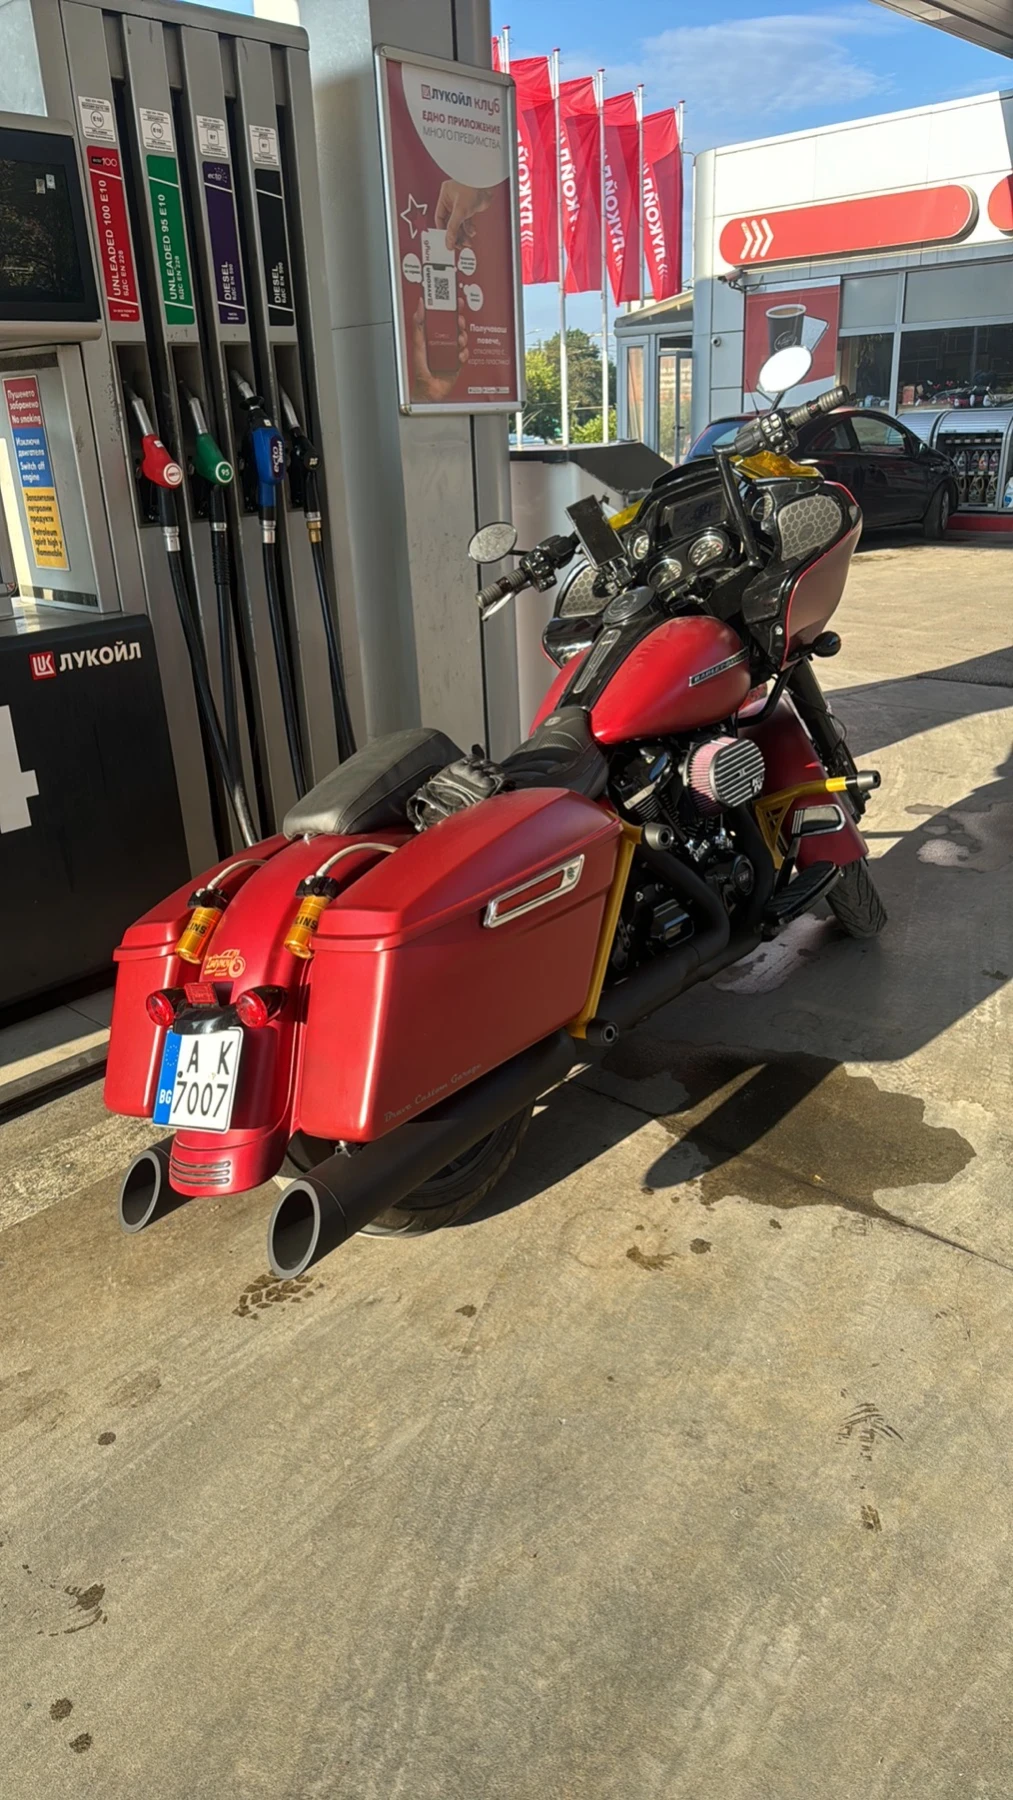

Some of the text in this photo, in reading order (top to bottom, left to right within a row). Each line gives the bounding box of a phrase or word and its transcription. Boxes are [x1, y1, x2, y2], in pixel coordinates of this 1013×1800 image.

[432, 88, 472, 108] ЛУКОЙЛ
[474, 98, 500, 116] клуб
[422, 110, 501, 135] ЕДНО ПРИЛОЖЕНИЕ
[422, 126, 501, 150] МНОГО ПРЕДИМСТВА
[208, 172, 222, 180] ecto
[98, 180, 120, 296] UNLEADED 100 E10
[158, 194, 178, 300] UNLEADED 95 E10
[118, 250, 126, 263] 228
[120, 264, 127, 277] EN
[176, 268, 182, 282] EN
[221, 261, 232, 300] DIESEL
[272, 266, 281, 304] DIESEL
[7, 390, 35, 401] Пушенето
[10, 401, 38, 412] забранено
[12, 413, 42, 424] No smoking
[20, 461, 46, 470] Switch off
[222, 468, 230, 476] 95
[22, 472, 40, 484] engine
[32, 527, 58, 536] Petroleum
[59, 640, 142, 672] ЛУКОЙЛ
[186, 1040, 234, 1076] A K
[158, 1089, 172, 1104] BG
[172, 1080, 228, 1118] 7007
